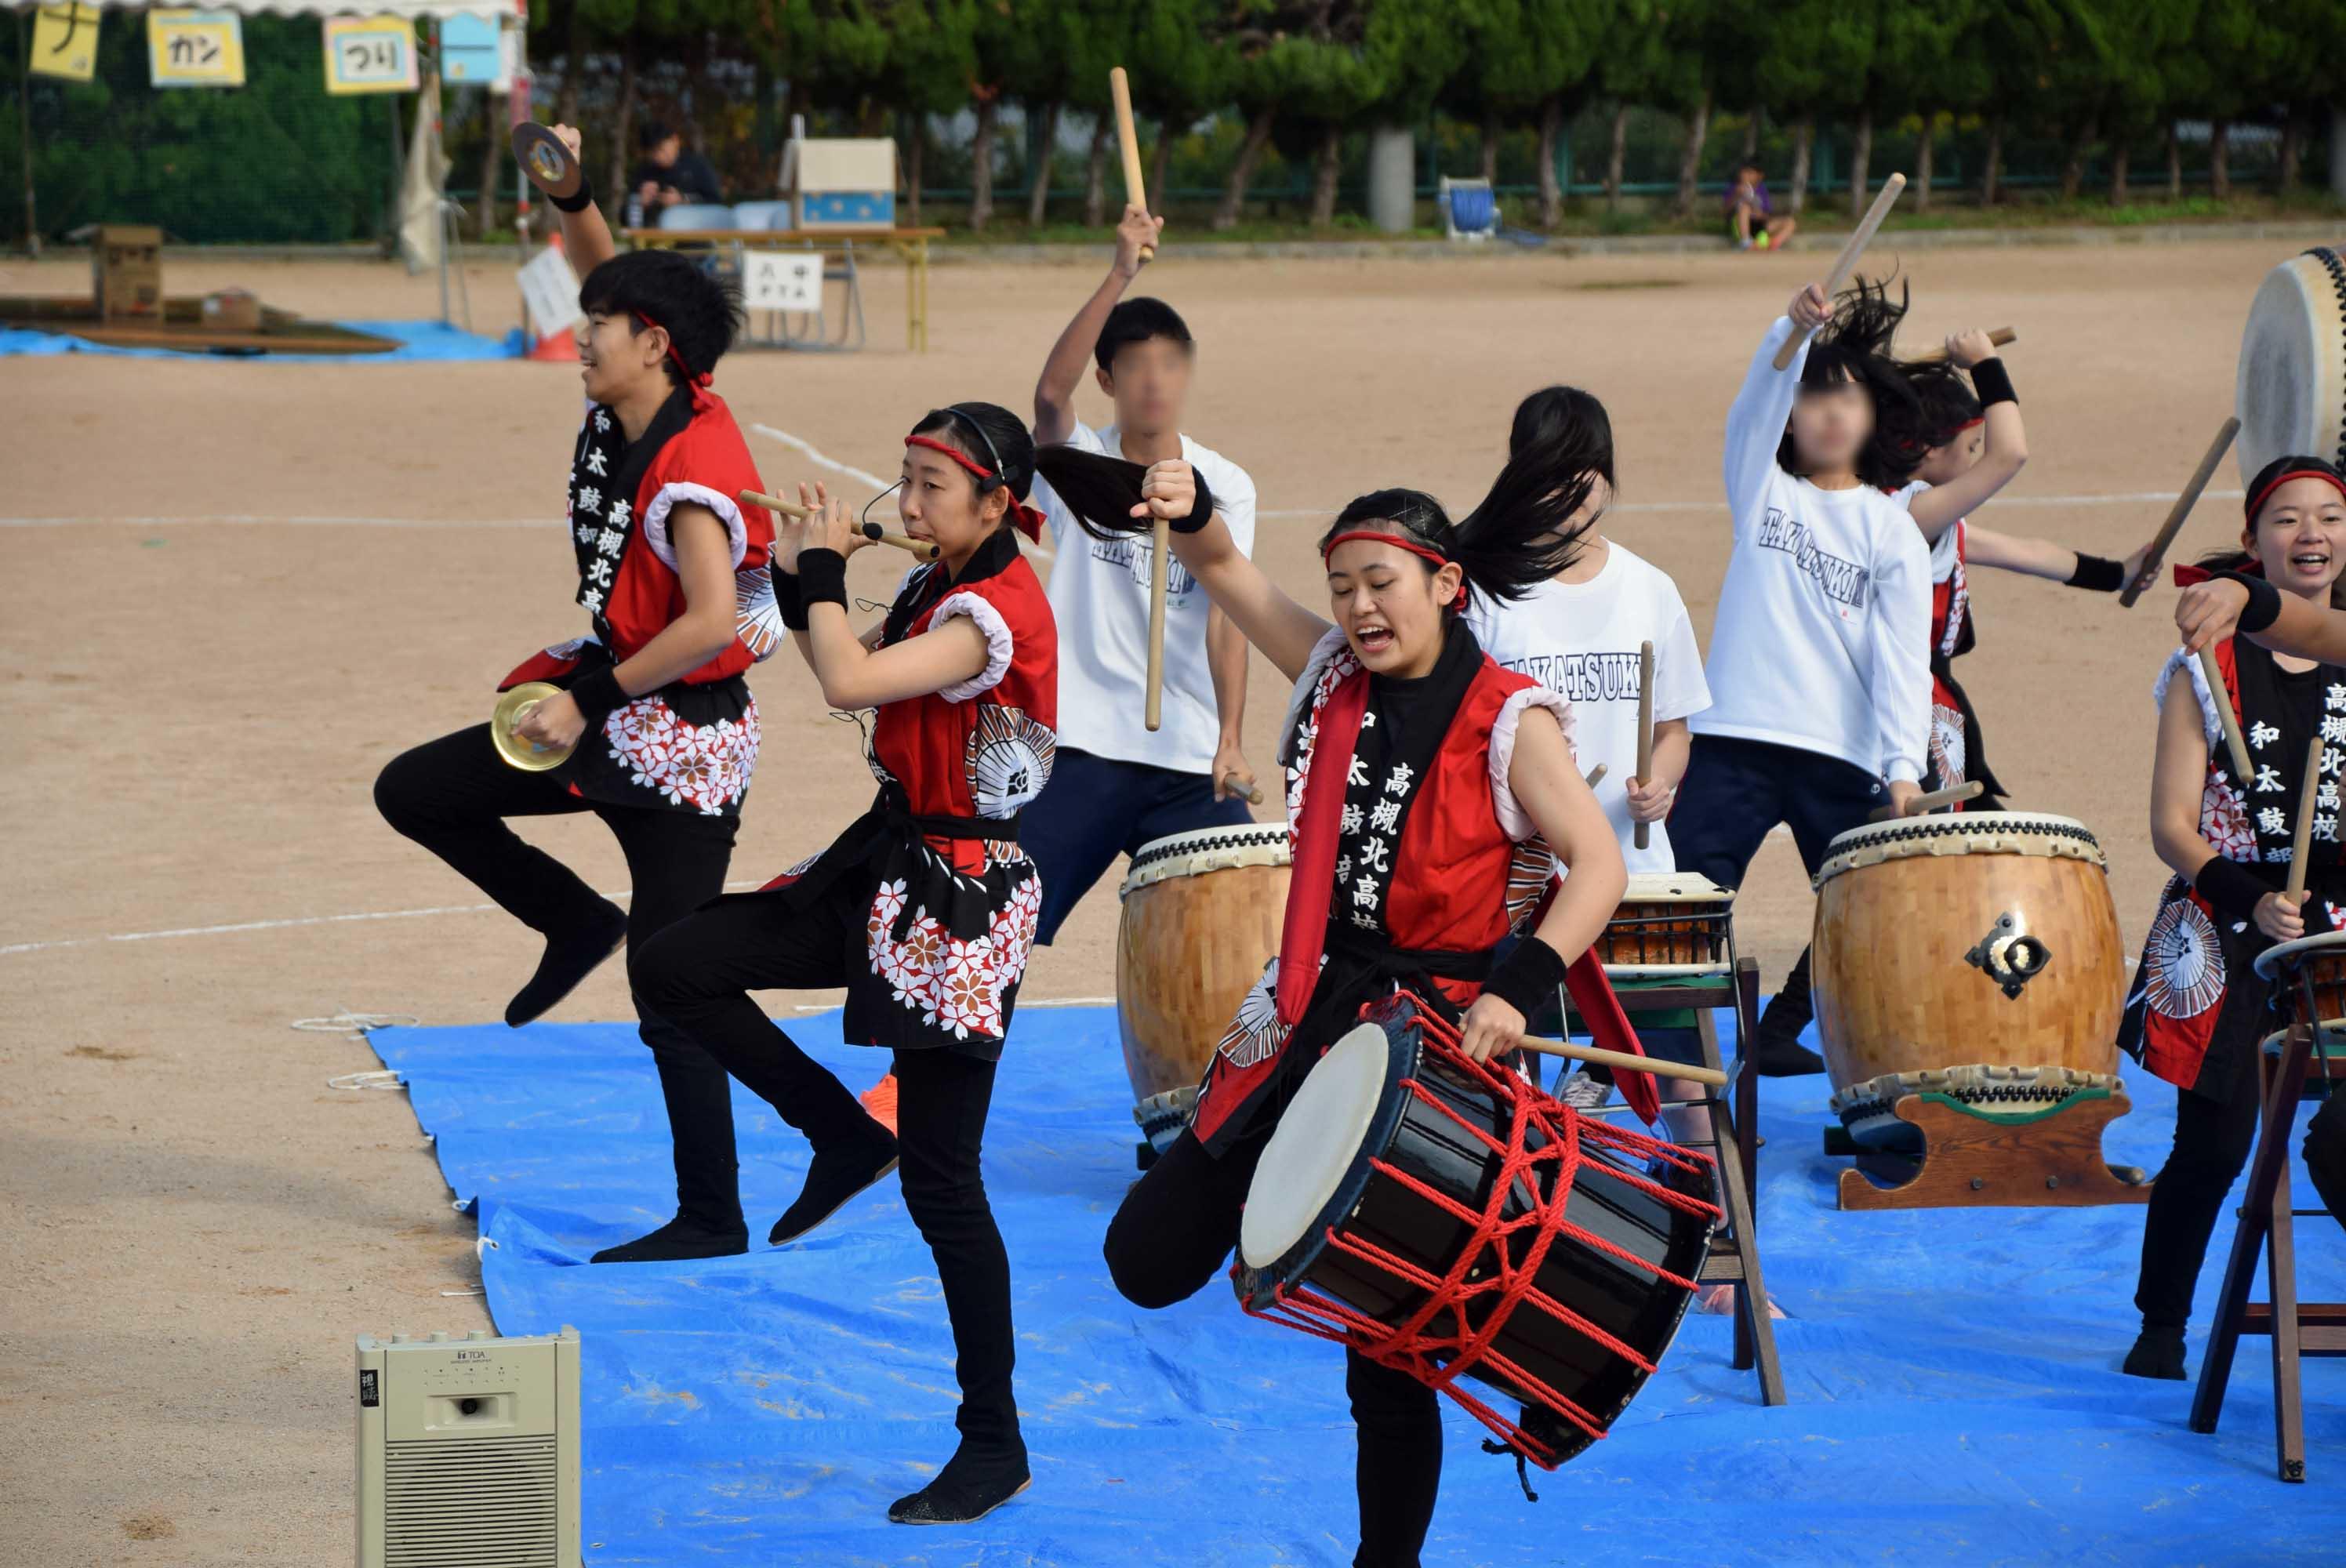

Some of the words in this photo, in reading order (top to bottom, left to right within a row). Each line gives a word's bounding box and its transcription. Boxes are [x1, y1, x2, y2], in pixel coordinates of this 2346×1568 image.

[169, 34, 220, 65] カン
[346, 41, 397, 71] つり
[581, 498, 633, 630] 高槻北高
[468, 1351, 485, 1359] TOA
